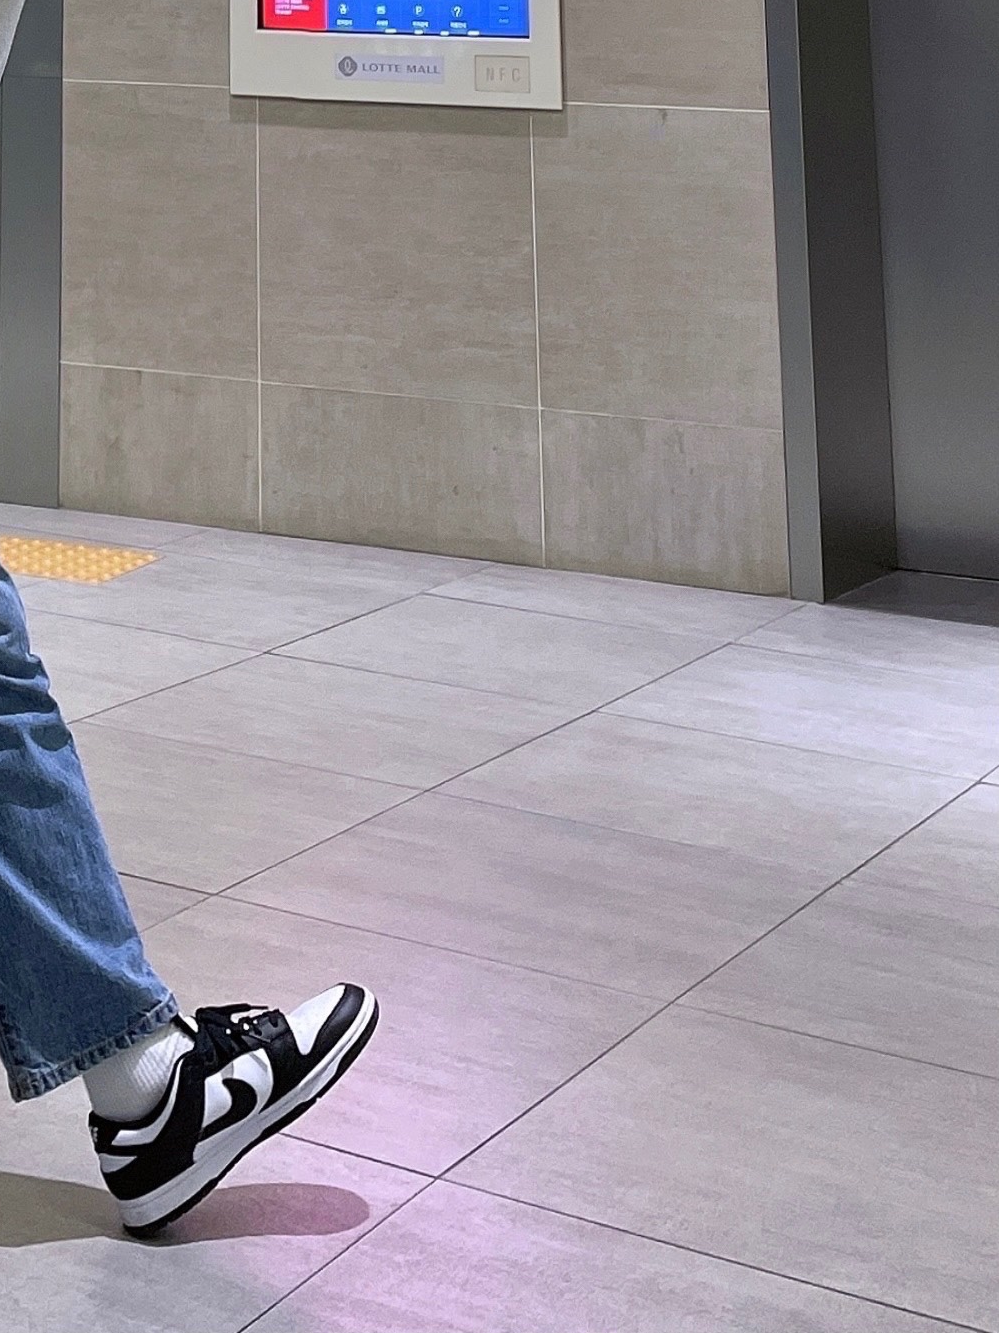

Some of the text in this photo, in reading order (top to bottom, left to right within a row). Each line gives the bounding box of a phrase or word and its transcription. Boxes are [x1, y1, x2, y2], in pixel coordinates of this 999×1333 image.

[362, 63, 441, 75] LOTTE MALL
[485, 67, 521, 82] NFC
